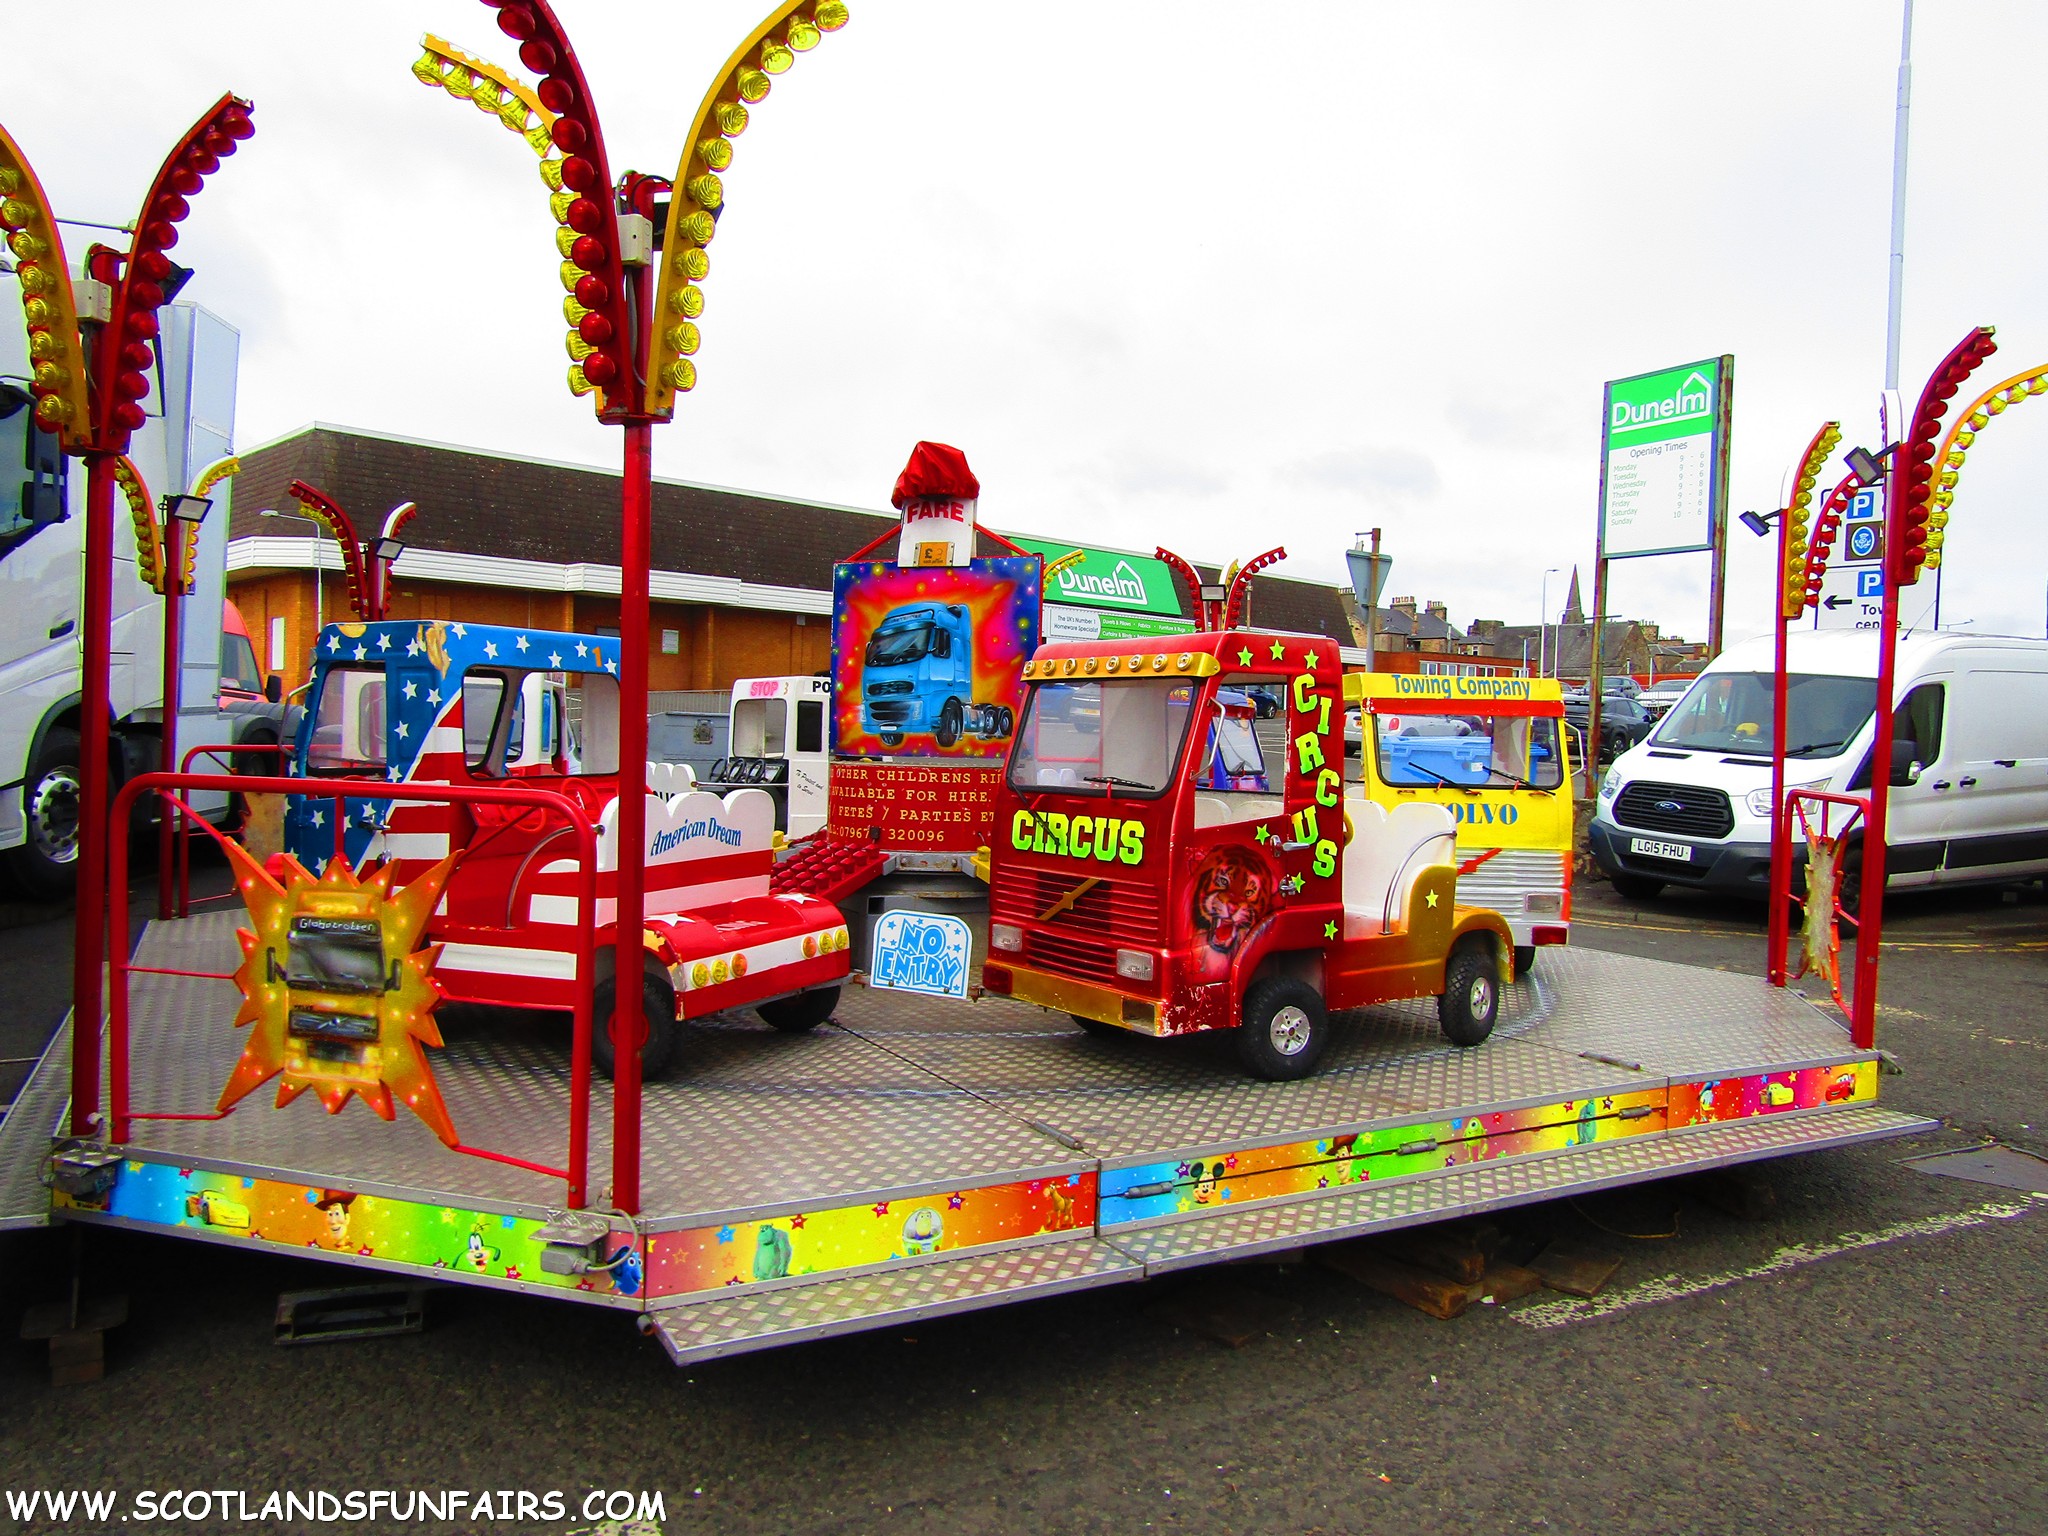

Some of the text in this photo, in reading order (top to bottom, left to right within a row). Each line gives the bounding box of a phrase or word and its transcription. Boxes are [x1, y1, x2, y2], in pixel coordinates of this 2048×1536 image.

[1612, 387, 1705, 428] Dunelm
[1630, 441, 1688, 459] Opening Times
[1614, 464, 1637, 472] Monday
[1700, 451, 1704, 459] 6
[1613, 480, 1647, 490] Wednesday
[1614, 472, 1637, 481] Tuesday
[1613, 490, 1640, 498] Thursday
[1679, 482, 1683, 490] 9
[907, 501, 964, 524] FARE
[1611, 508, 1638, 517] Saturday
[1853, 494, 1870, 516] P
[1611, 518, 1633, 526] Sunday
[1058, 566, 1142, 599] Dunelm
[1863, 573, 1881, 595] P
[1054, 623, 1098, 633] Homeware Specialist
[1856, 621, 1902, 629] cene
[592, 646, 602, 667] 1
[750, 681, 779, 697] STOP
[1392, 674, 1530, 700] Towing Company
[836, 769, 869, 780] OTHER
[876, 770, 971, 784] CHILDRENS
[831, 786, 895, 799] AVAILABLE
[906, 789, 938, 801] FOR
[838, 805, 873, 819] FETES
[899, 809, 971, 822] PARTIES
[1442, 802, 1518, 825] OLVO
[650, 817, 742, 857] American Dream
[888, 828, 945, 842] 320096
[1011, 809, 1146, 865] CIRCUS
[1637, 840, 1684, 857] LG15 FHU
[899, 919, 946, 956] NO
[879, 948, 961, 988] ENTRY
